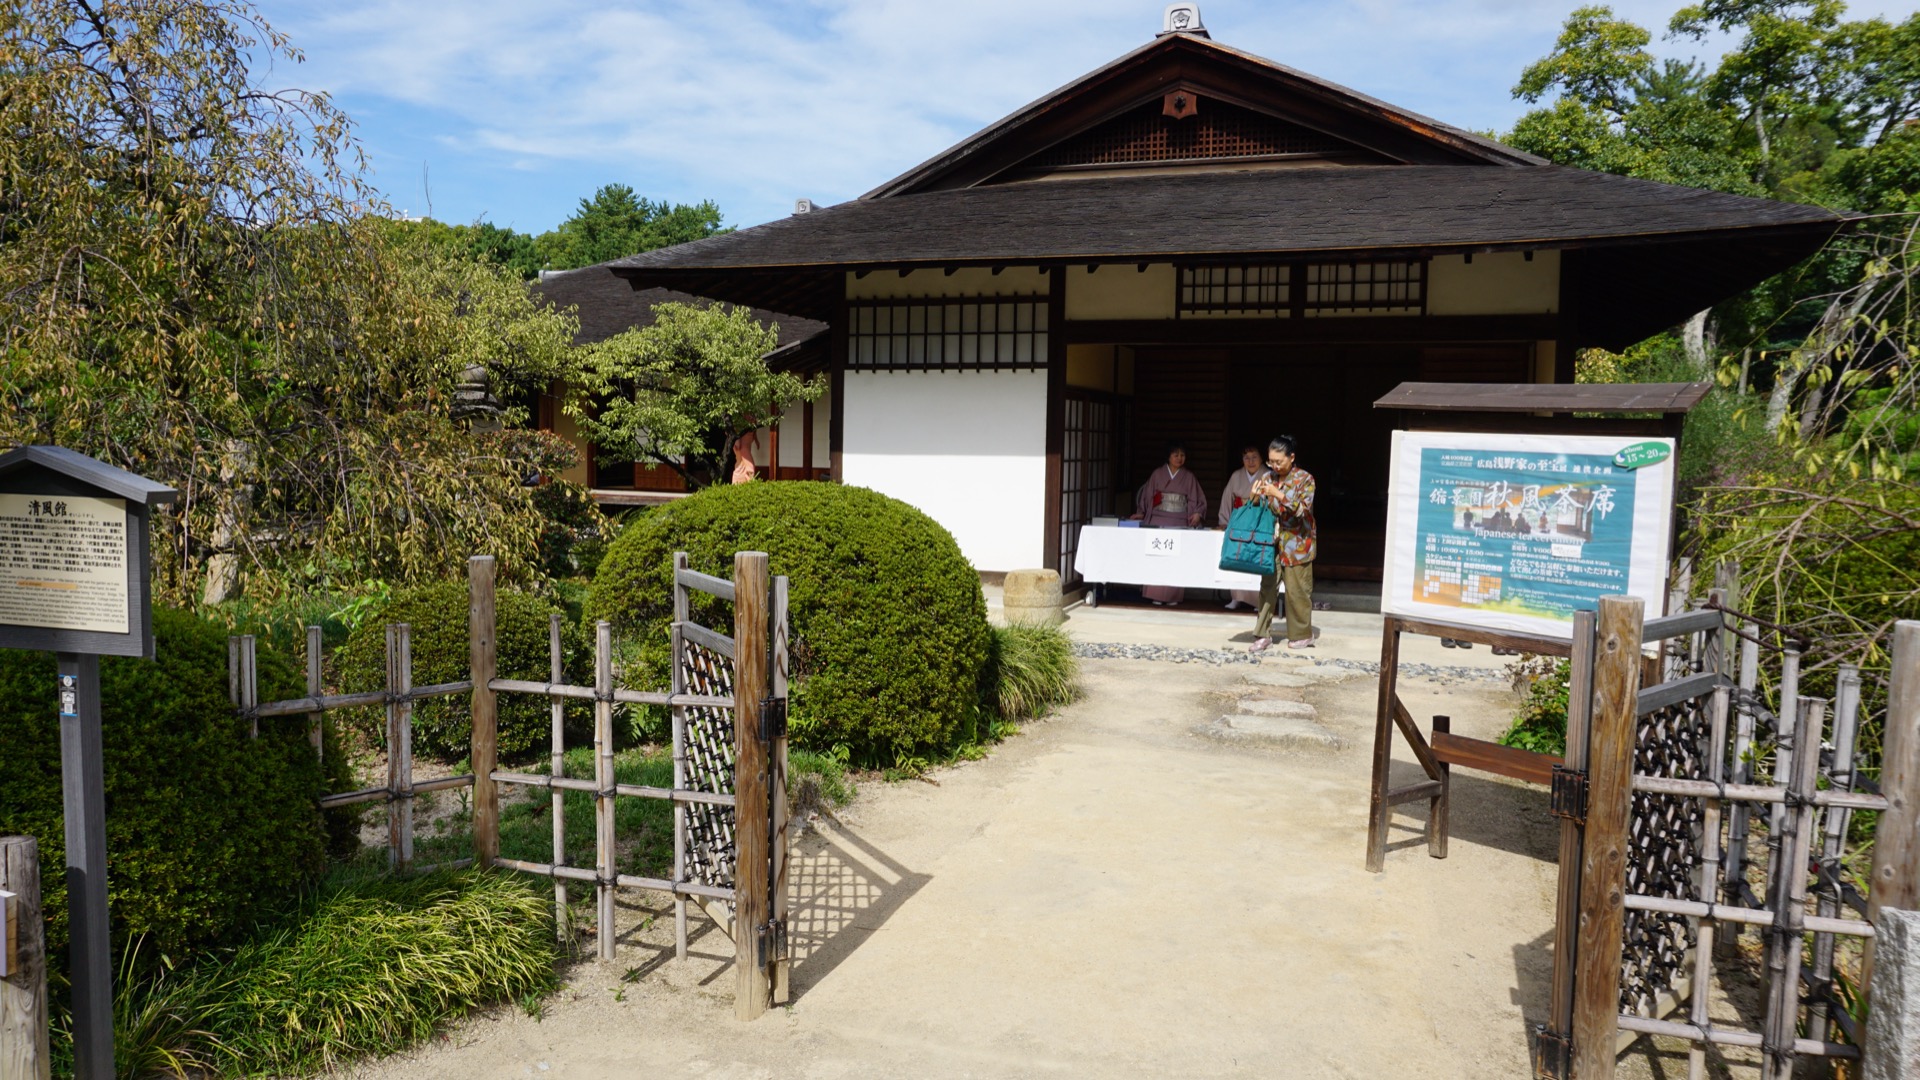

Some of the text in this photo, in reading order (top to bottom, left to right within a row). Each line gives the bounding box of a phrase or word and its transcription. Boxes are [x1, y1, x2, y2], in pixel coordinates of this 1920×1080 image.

[1624, 445, 1644, 454] about
[1627, 453, 1638, 463] 15
[1646, 448, 1659, 459] 20
[1429, 480, 1617, 520] 縮景園 秋風茶席
[28, 499, 67, 517] 清風館
[1475, 528, 1516, 540] Japanese
[1518, 531, 1533, 541] tea
[1151, 537, 1174, 551] 受付
